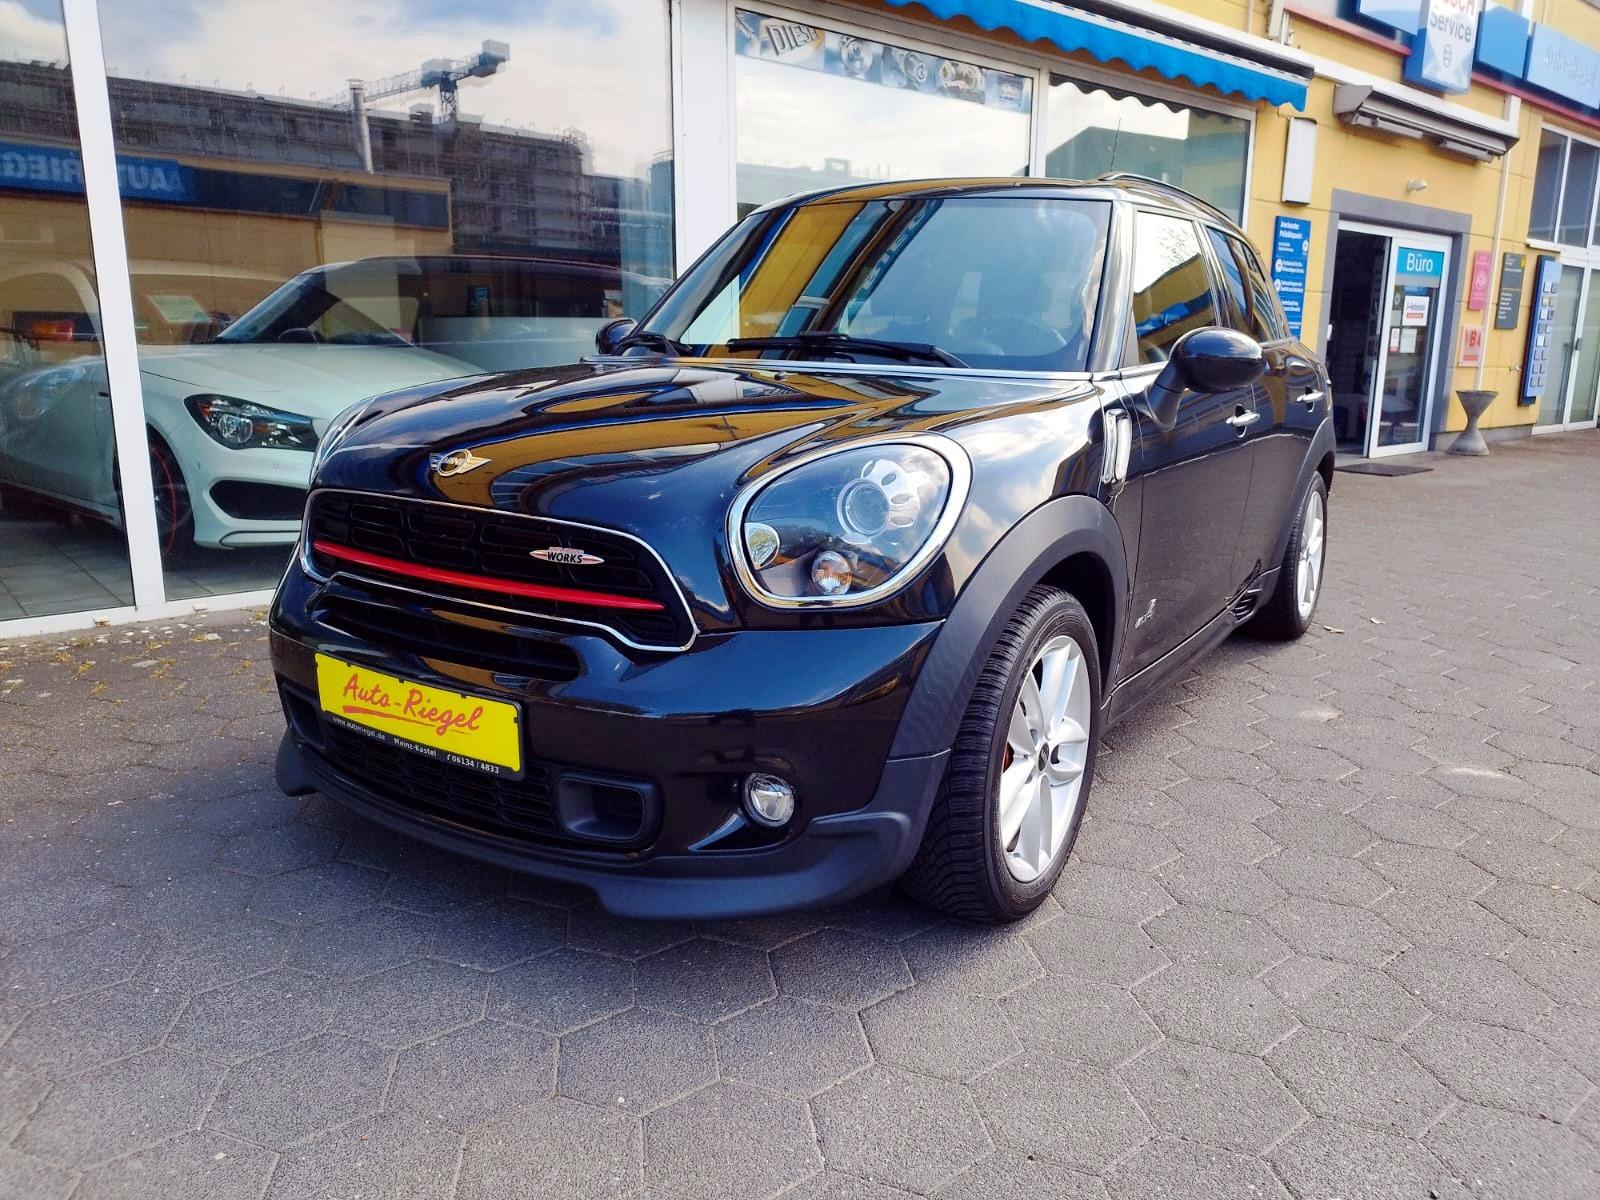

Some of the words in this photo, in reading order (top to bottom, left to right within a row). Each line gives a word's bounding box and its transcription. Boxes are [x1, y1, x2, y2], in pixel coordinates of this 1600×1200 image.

[1429, 4, 1472, 43] Service
[1406, 252, 1434, 273] Büro
[546, 551, 583, 564] WORKS
[342, 673, 484, 736] Auto-Riegel
[393, 737, 437, 757] Mainz-Kastel
[452, 755, 475, 768] 06134
[480, 762, 500, 774] 4833
